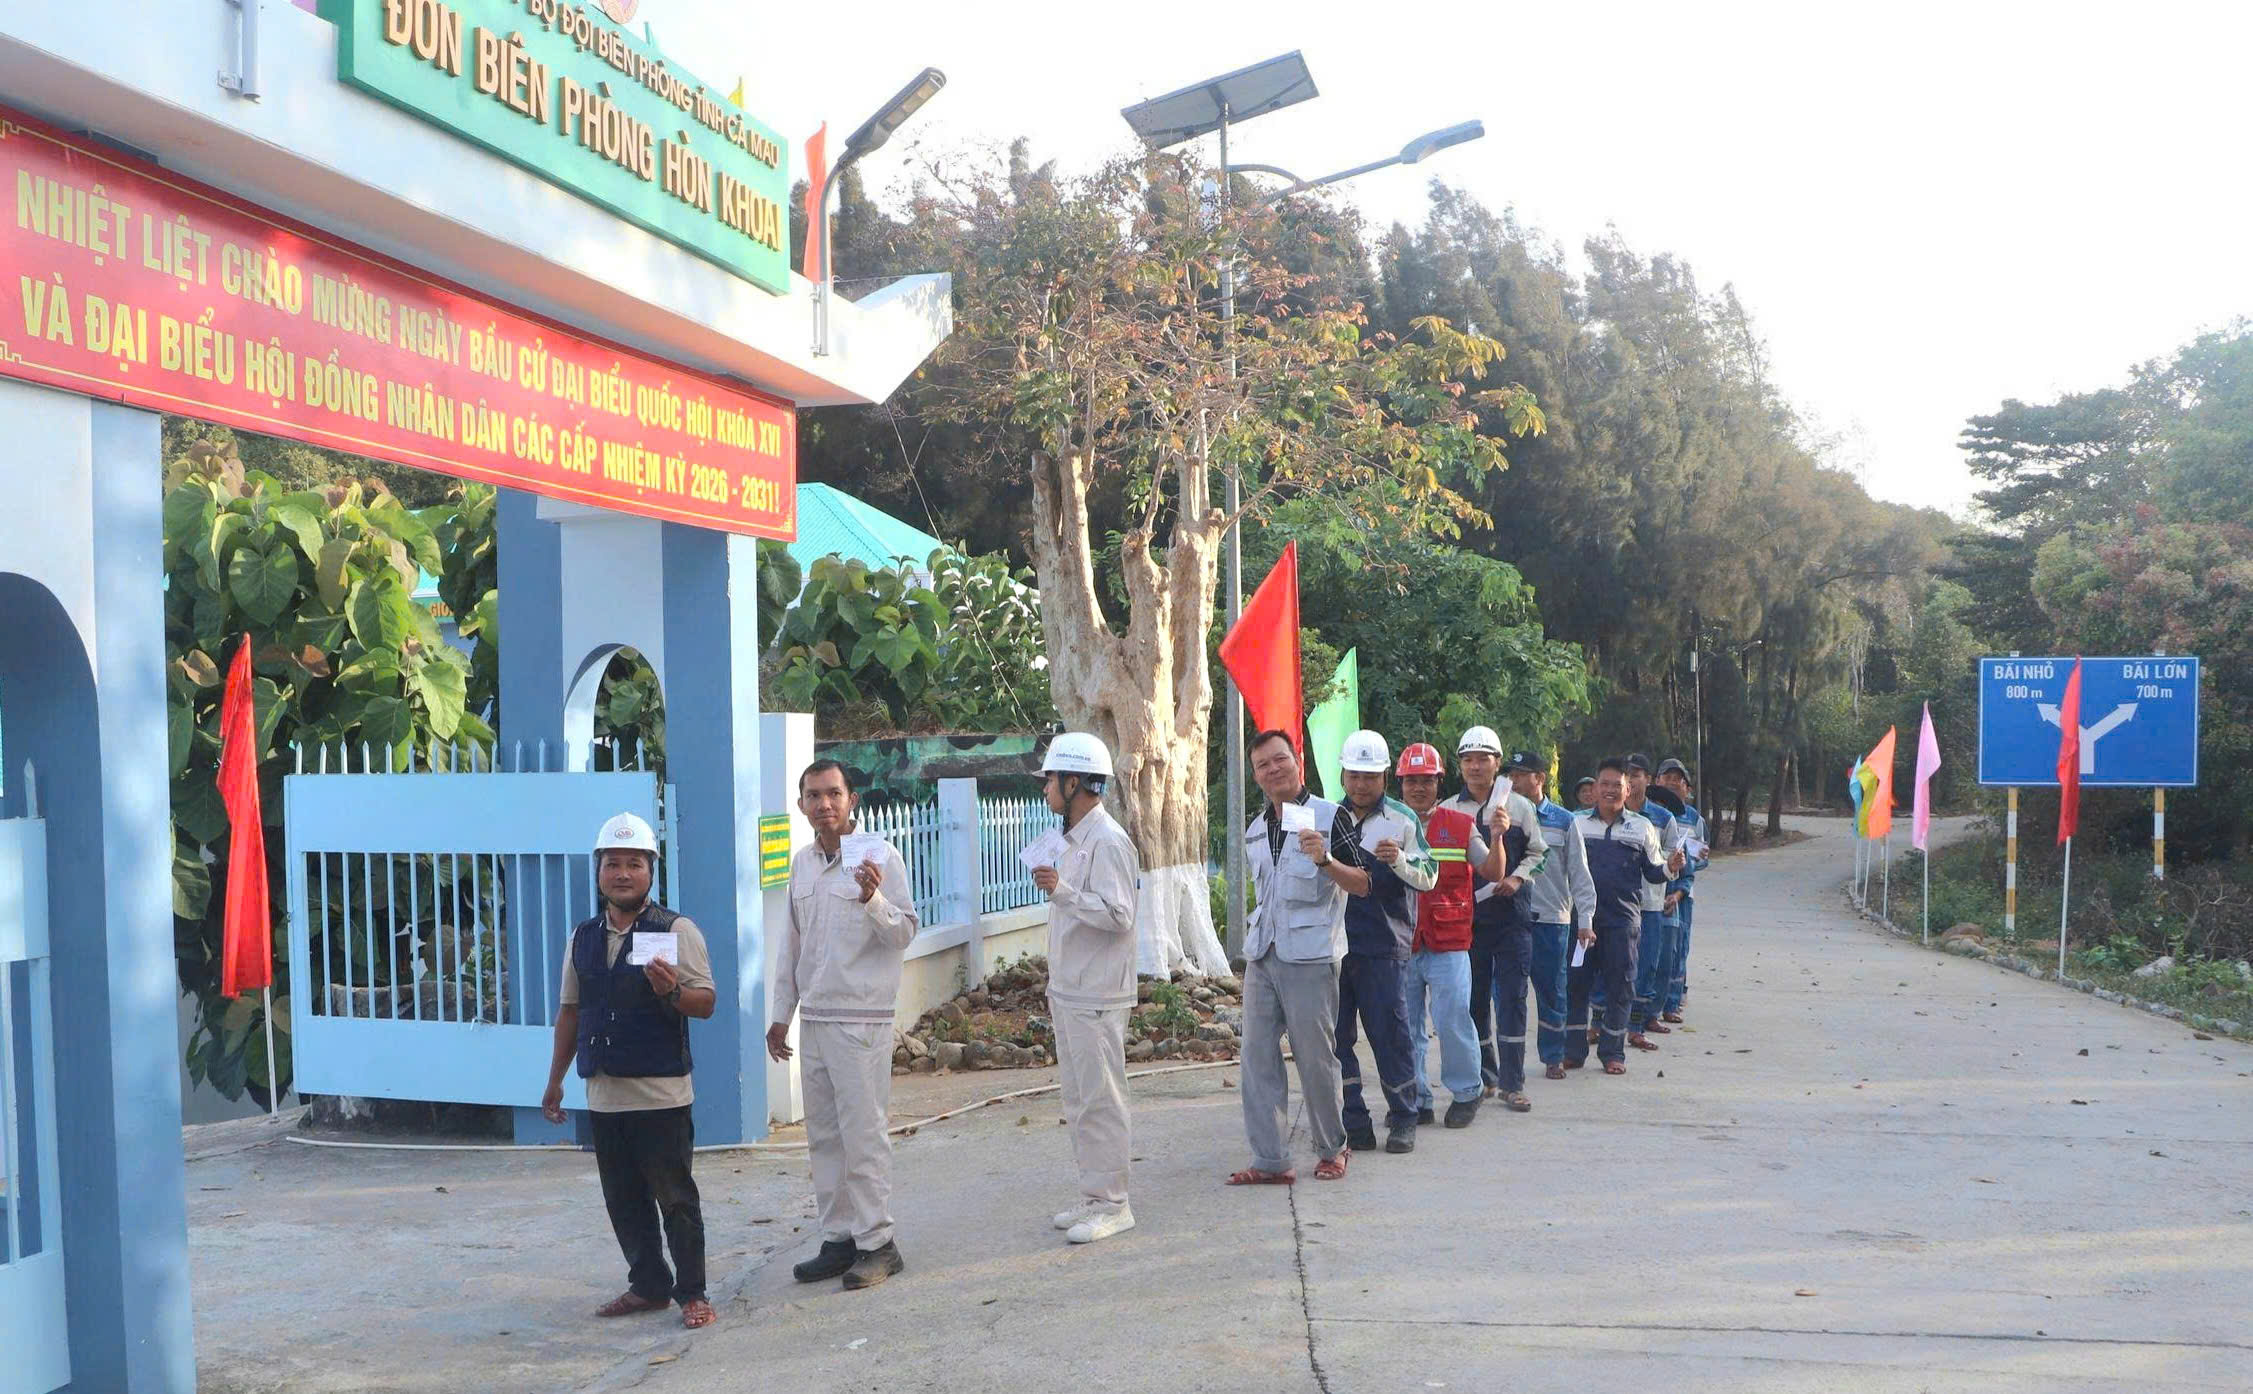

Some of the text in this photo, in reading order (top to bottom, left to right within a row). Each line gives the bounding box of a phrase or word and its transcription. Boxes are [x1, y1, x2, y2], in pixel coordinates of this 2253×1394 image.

[559, 3, 593, 53] ĐỘI
[594, 27, 634, 77] BIÊN
[635, 54, 693, 112] PHÒNG
[692, 85, 724, 134] TỈNH
[724, 113, 747, 149] CÀ
[747, 129, 779, 169] MAU
[474, 25, 549, 125] BIÊN
[559, 76, 656, 182] PHÒNG
[660, 130, 712, 214] HÒN
[717, 171, 781, 252] KHOAI
[17, 169, 781, 457] NHIỆT LIỆT CHÀO MỪNG NGÀY BẦU CỬ ĐẠI BIỂU QUỐC HỘI KHÓA XVI
[20, 271, 73, 346] VÀ
[85, 294, 147, 373] ĐẠI
[160, 306, 235, 385] BIỂU
[245, 336, 295, 409] HỘI
[303, 347, 380, 422] ĐỒNG
[386, 380, 454, 442] NHÂN
[461, 399, 507, 455] DÂN
[513, 409, 554, 466] CÁC
[559, 421, 598, 475] CẤP
[603, 440, 661, 496] NHIỆM
[665, 453, 687, 495] KỲ
[690, 464, 728, 504] 2026
[741, 478, 780, 514] 2031!
[1994, 660, 2054, 680] BÃI NHỎ
[2006, 685, 2043, 699] 800 m
[2123, 659, 2187, 679] BÃI LỚN
[2136, 685, 2173, 698] 700 m
